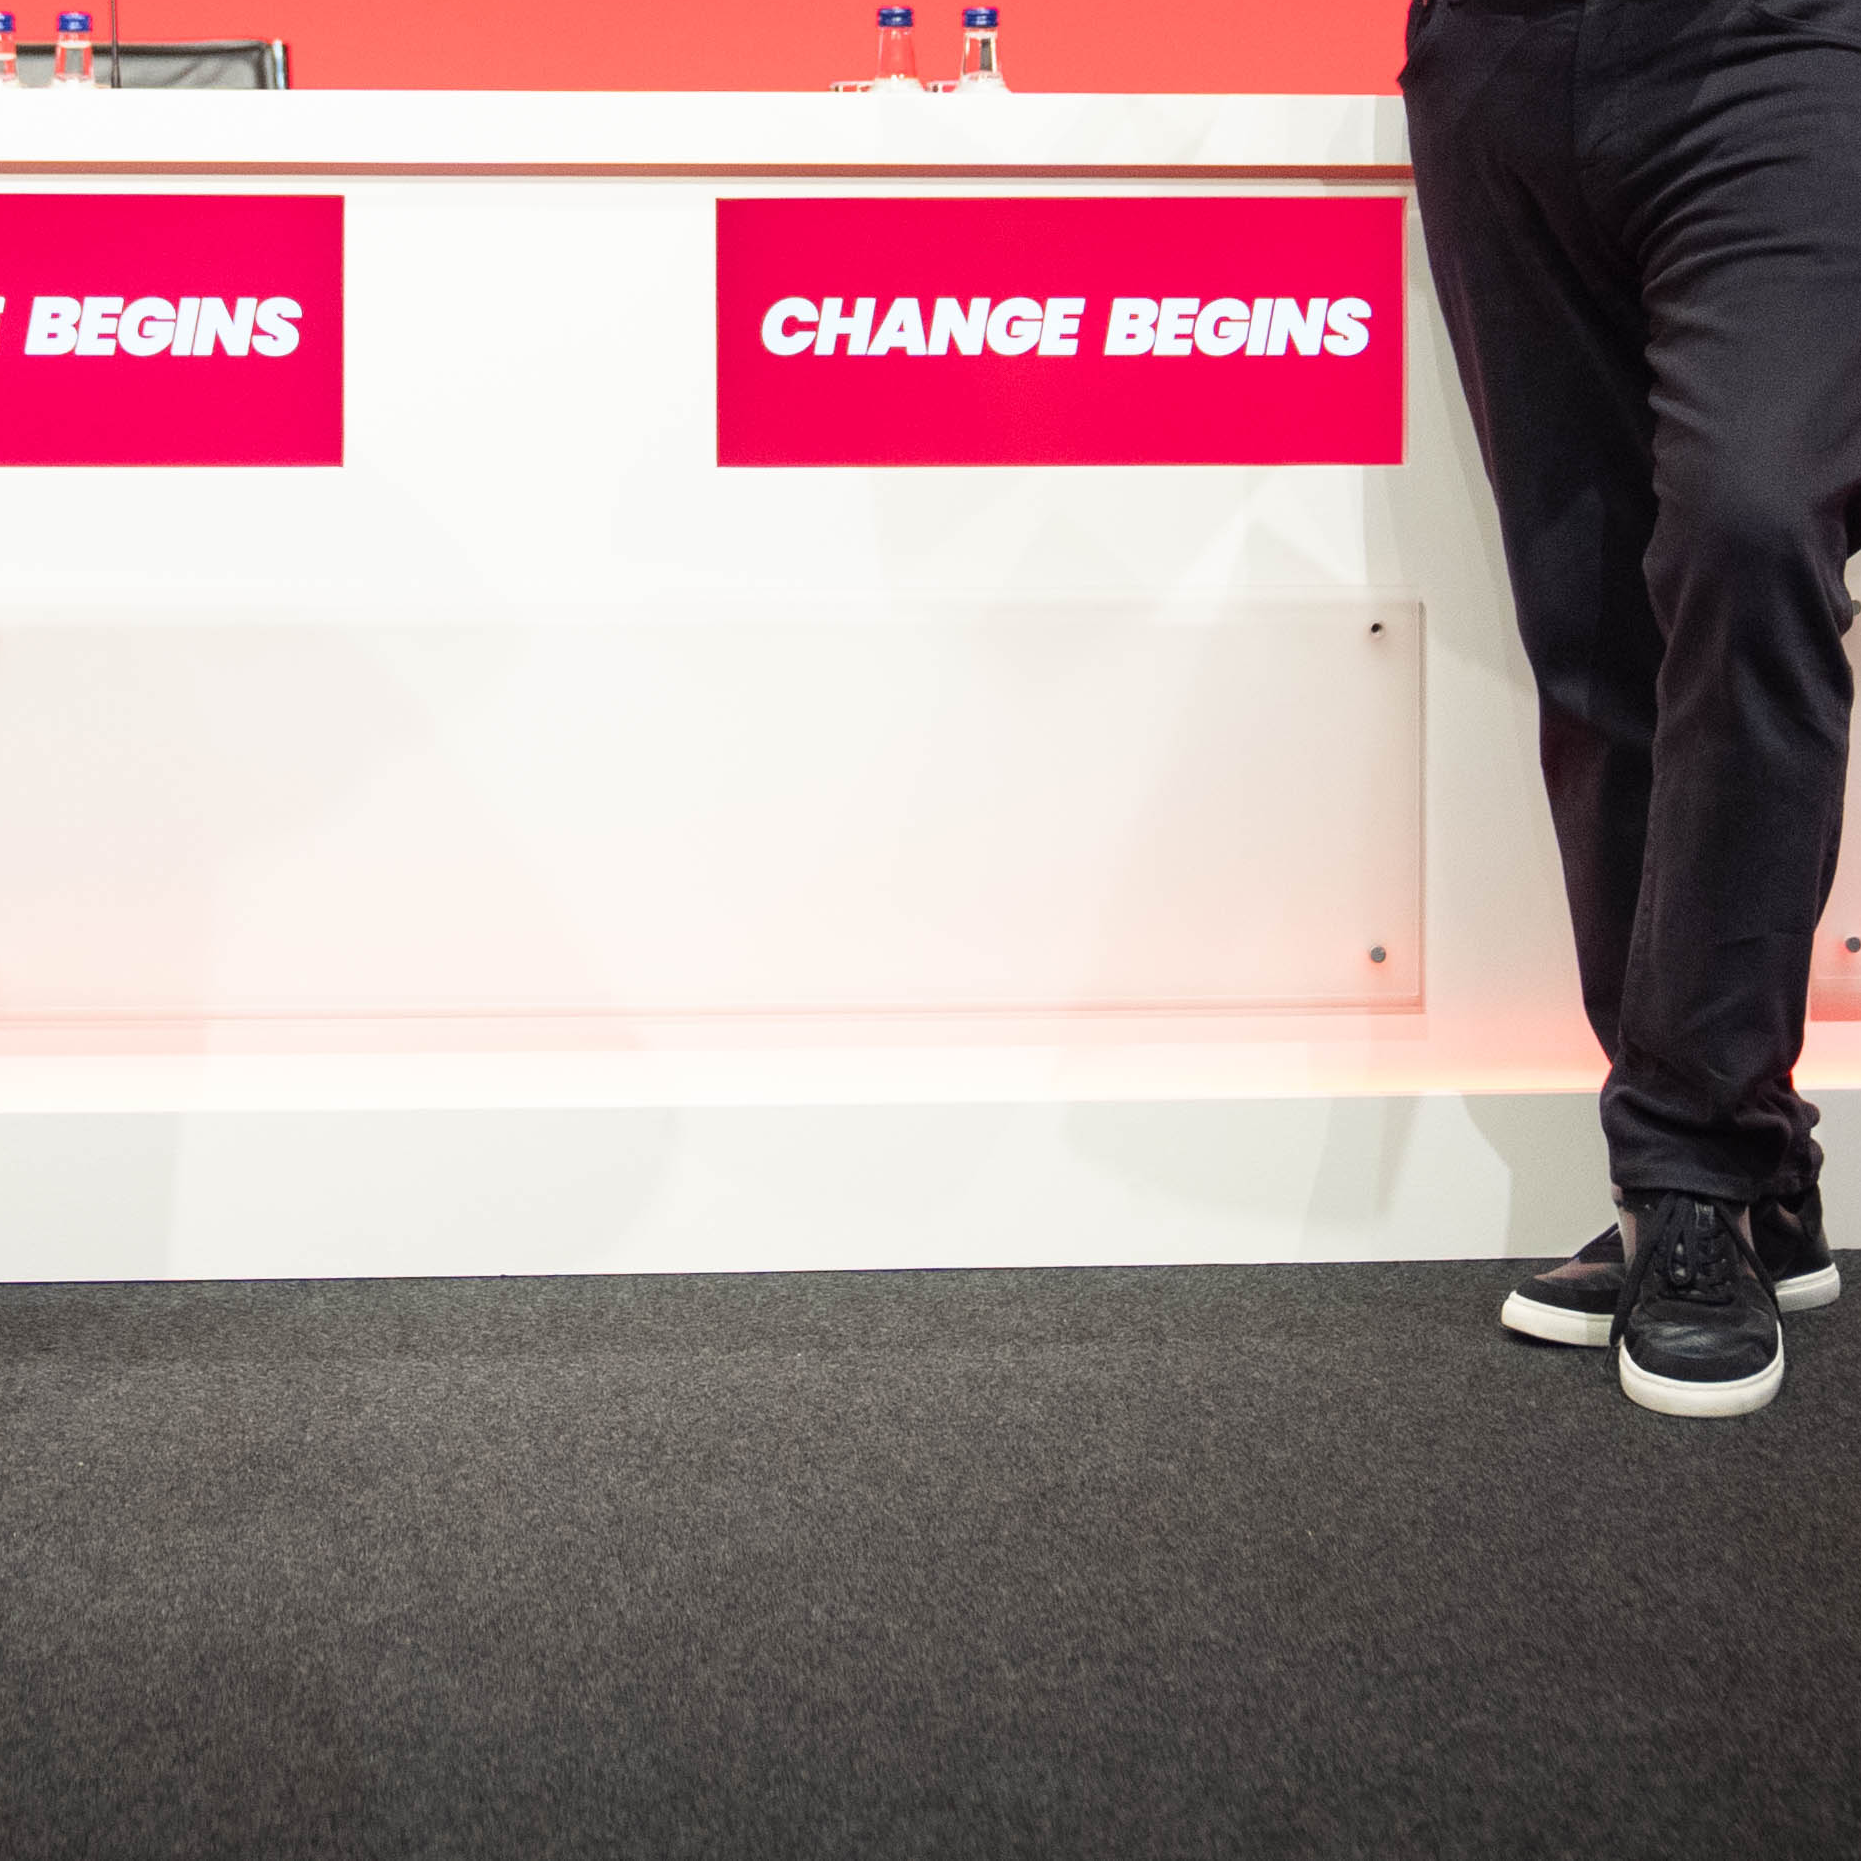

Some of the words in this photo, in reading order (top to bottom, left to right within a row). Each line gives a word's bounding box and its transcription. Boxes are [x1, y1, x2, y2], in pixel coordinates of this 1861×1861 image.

[23, 295, 303, 358] BEGINS
[760, 296, 1086, 357] CHANGE
[1103, 296, 1372, 357] BEGINS
